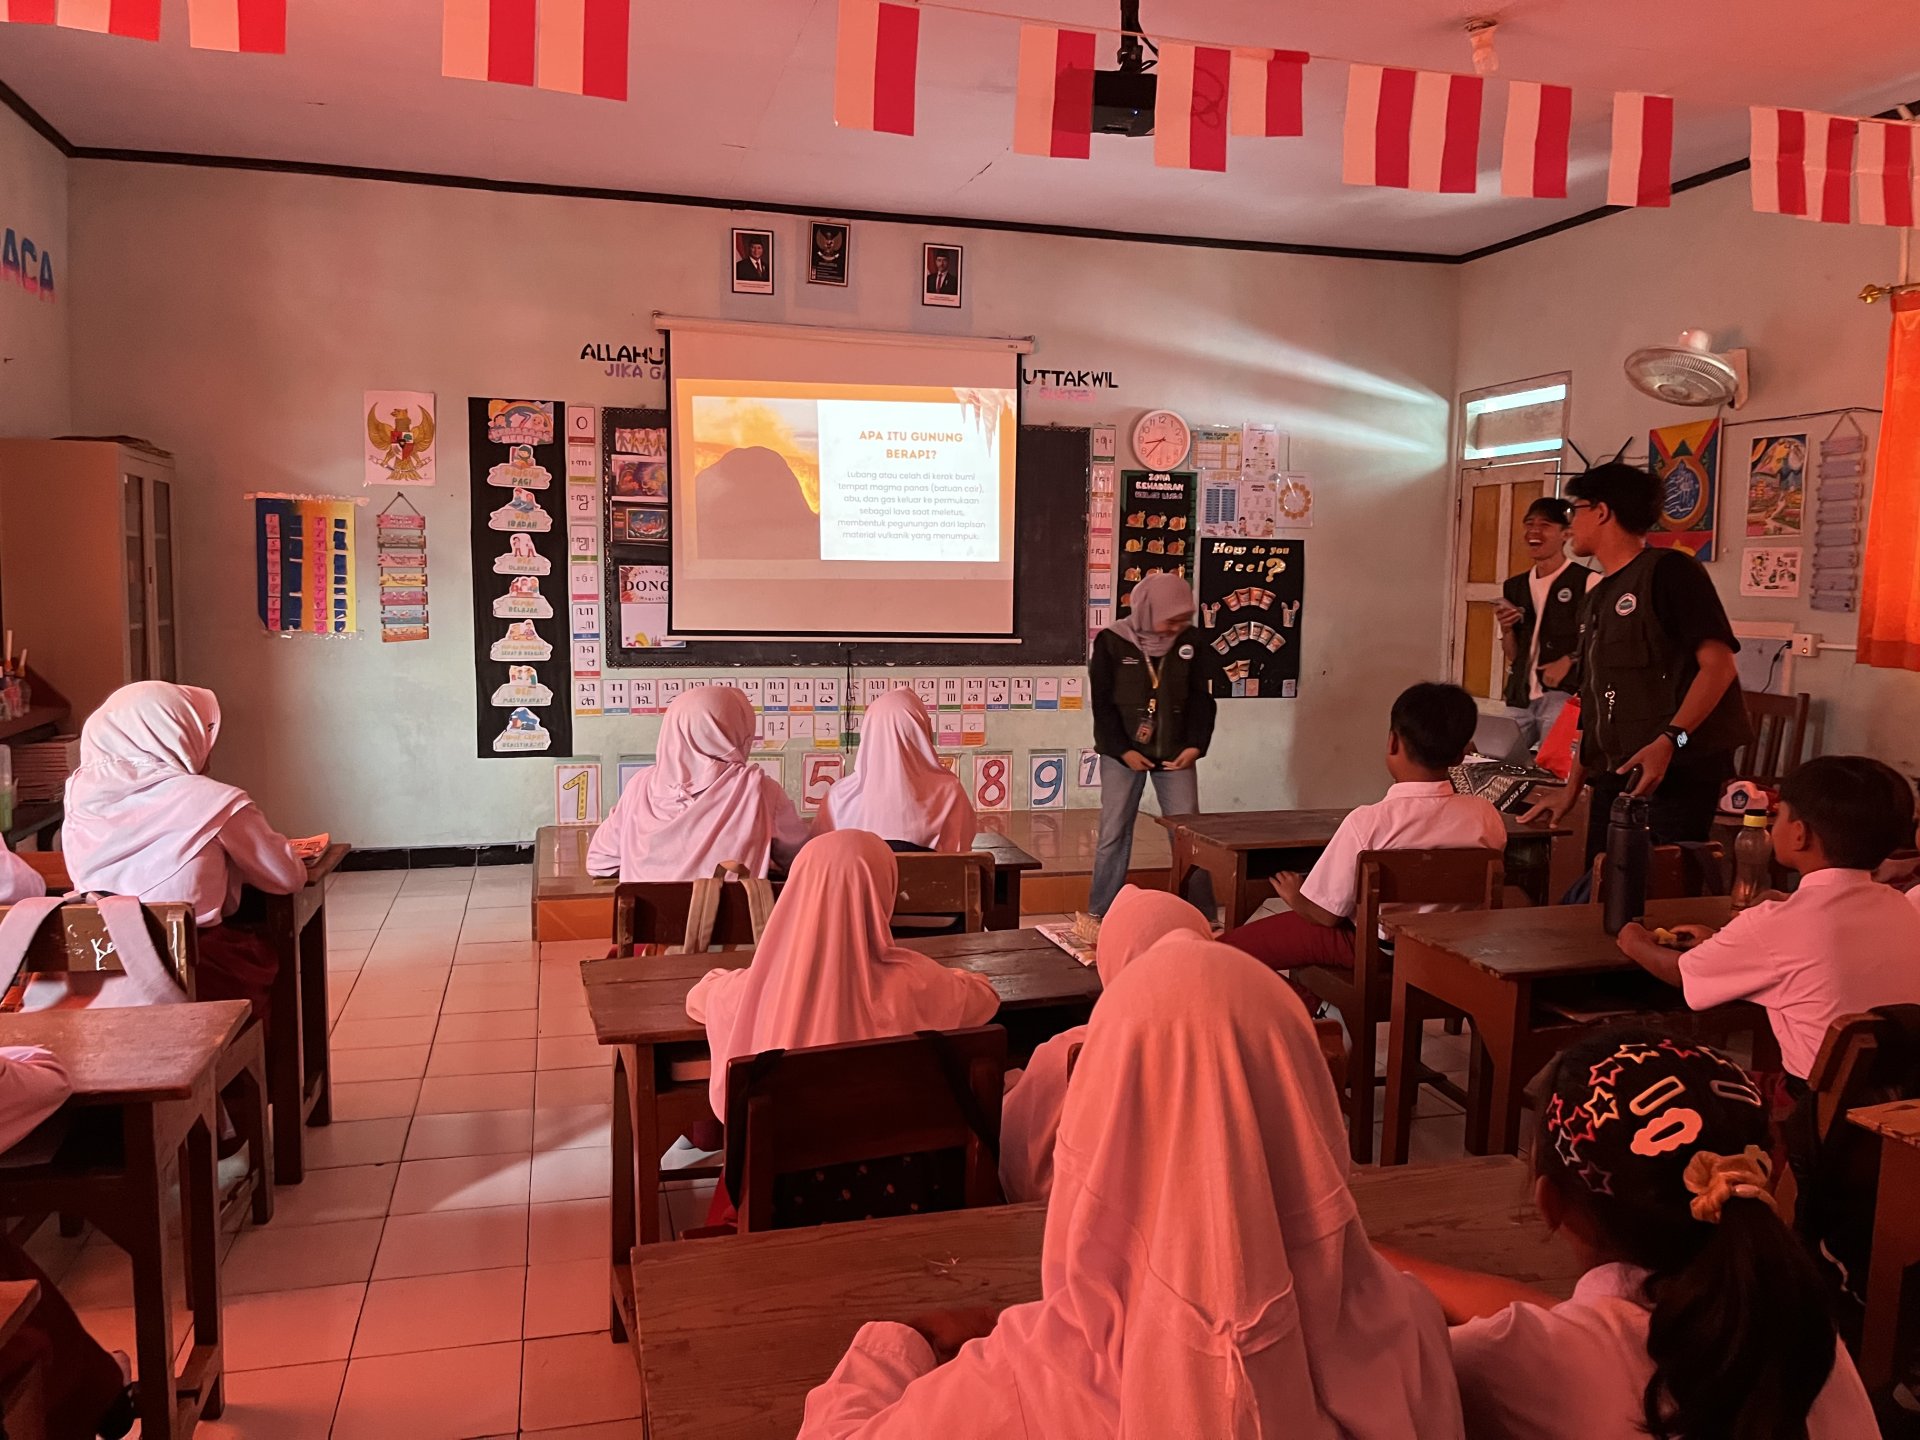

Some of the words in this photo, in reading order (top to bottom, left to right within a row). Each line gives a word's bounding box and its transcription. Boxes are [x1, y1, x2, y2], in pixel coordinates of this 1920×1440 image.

[1, 227, 57, 304] ACA
[580, 343, 664, 365] ALLAHU
[604, 363, 643, 378] JIKA
[649, 366, 666, 380] G
[1022, 368, 1119, 388] UTTAKWIL
[859, 431, 884, 441] APA
[887, 431, 907, 442] ITU
[911, 432, 964, 442] GUNUNG
[886, 449, 937, 460] BERAPI?
[511, 477, 532, 486] PAGI
[847, 471, 877, 480] Lubang
[899, 472, 922, 480] celah
[932, 473, 954, 481] kerak
[955, 473, 976, 481] bumi
[838, 483, 868, 493] tempat
[869, 484, 902, 493] magma
[903, 485, 929, 493] panas
[930, 483, 963, 494] (batuan
[843, 495, 861, 503] abu,
[863, 495, 879, 503] dan
[880, 497, 896, 505] gas
[897, 496, 922, 504] keluar
[923, 496, 933, 504] ke
[934, 496, 980, 506] permukaan
[859, 507, 892, 517] sebagai
[893, 507, 911, 515] lava
[912, 508, 930, 516] saat
[837, 519, 886, 527] membentuk
[887, 519, 939, 529] pegunungan
[940, 520, 956, 528] dari
[956, 520, 986, 530] lapisan
[842, 531, 876, 539] material
[877, 531, 910, 540] vulkanik
[911, 533, 931, 541] yang
[1212, 542, 1247, 556] How
[1252, 545, 1265, 555] do
[1269, 546, 1290, 556] you
[1223, 557, 1287, 583] Feel?
[806, 761, 841, 805] 5
[978, 759, 1007, 807] 8
[1033, 758, 1064, 805] 9
[563, 771, 588, 820] 1
